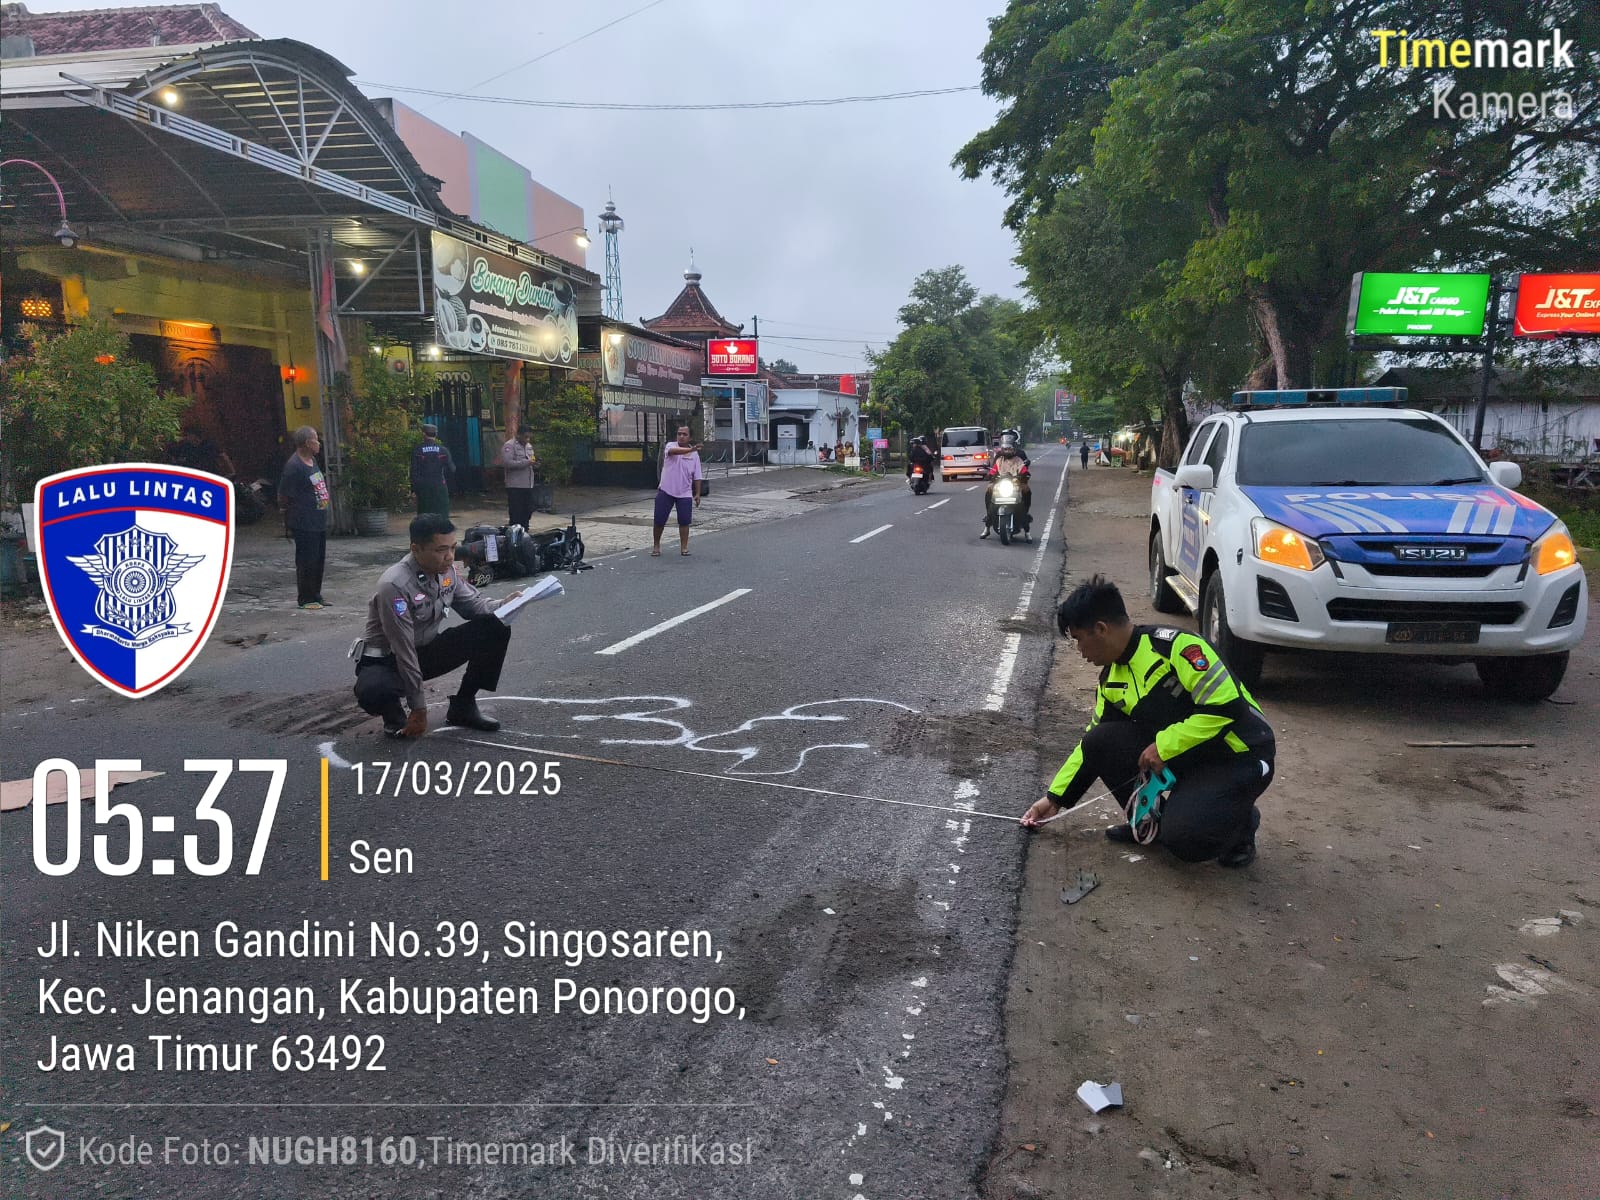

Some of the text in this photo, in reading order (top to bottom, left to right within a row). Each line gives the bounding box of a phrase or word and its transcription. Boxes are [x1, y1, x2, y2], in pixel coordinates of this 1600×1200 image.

[470, 257, 554, 310] Borang Durian
[1387, 287, 1460, 305] J&T CARGO
[1535, 288, 1596, 309] J&T
[627, 337, 648, 361] SOTO
[711, 354, 755, 364] SOTO BORANG
[1284, 492, 1499, 503] POLISI
[1400, 548, 1466, 560] ISUZU
